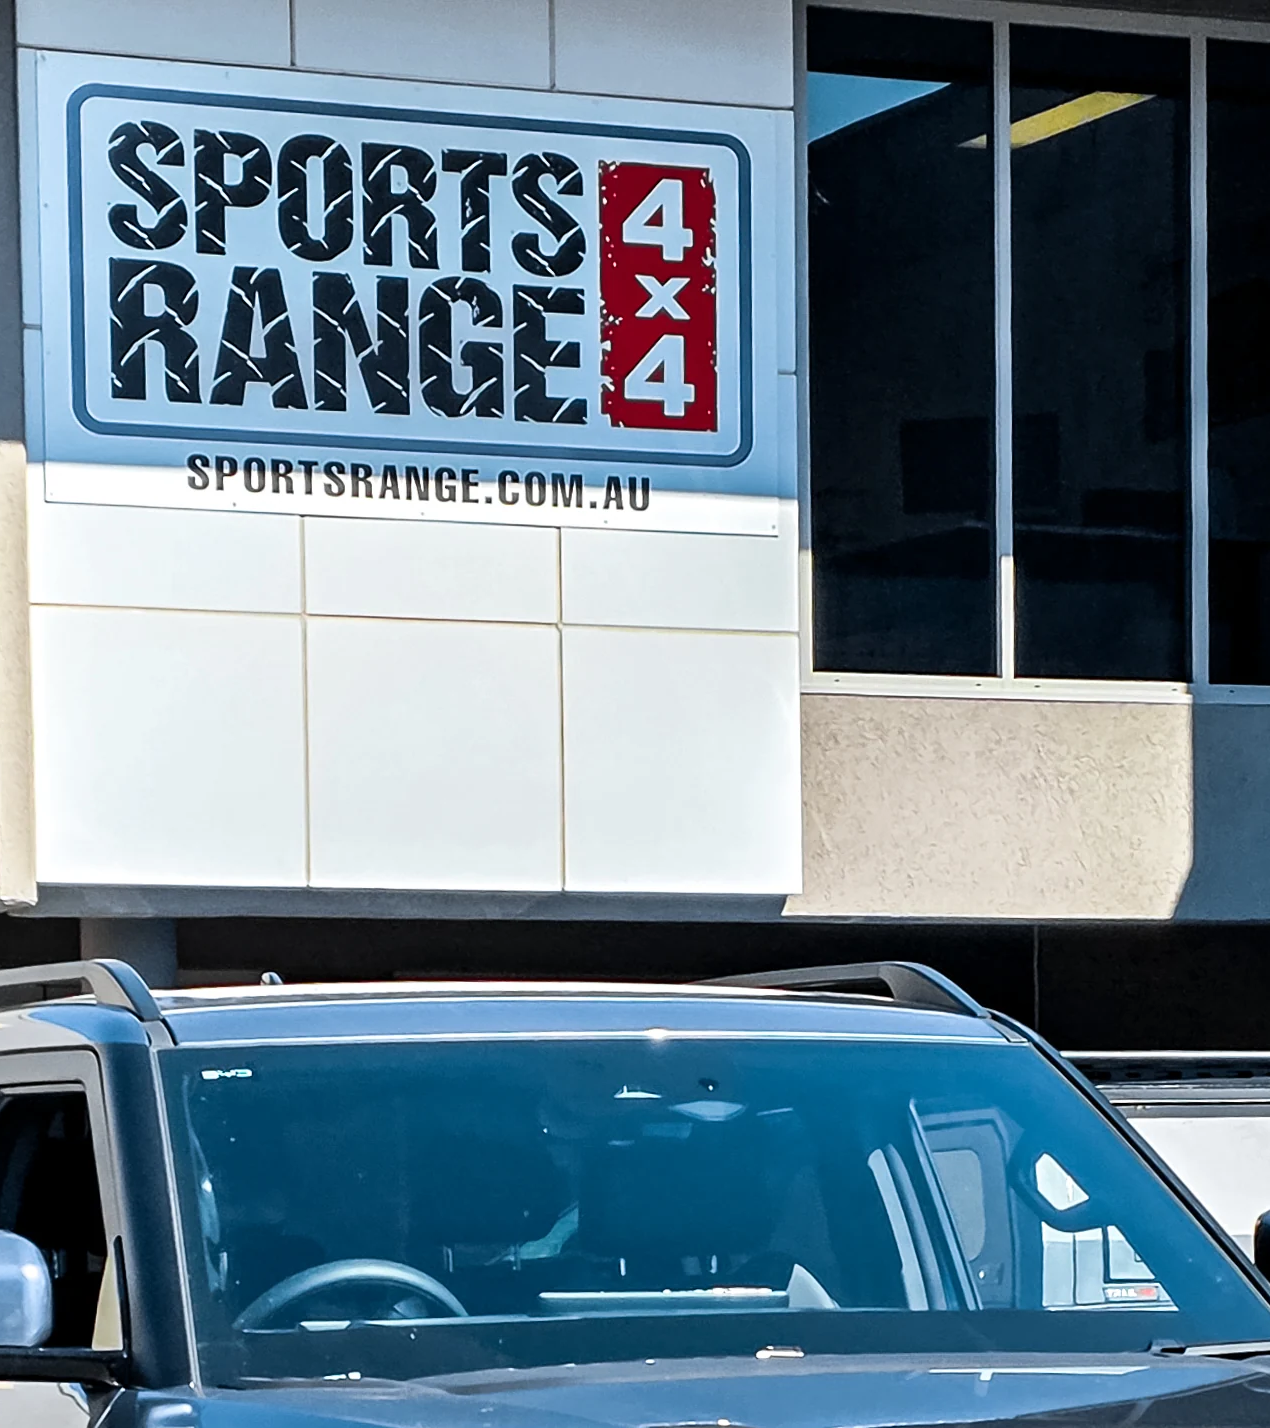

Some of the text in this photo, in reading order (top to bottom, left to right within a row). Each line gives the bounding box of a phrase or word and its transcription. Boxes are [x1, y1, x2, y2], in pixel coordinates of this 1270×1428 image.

[107, 119, 587, 278] SPORTS
[108, 257, 589, 425] RANGE
[186, 452, 652, 512] SPORTSRANGE.COM.AU
